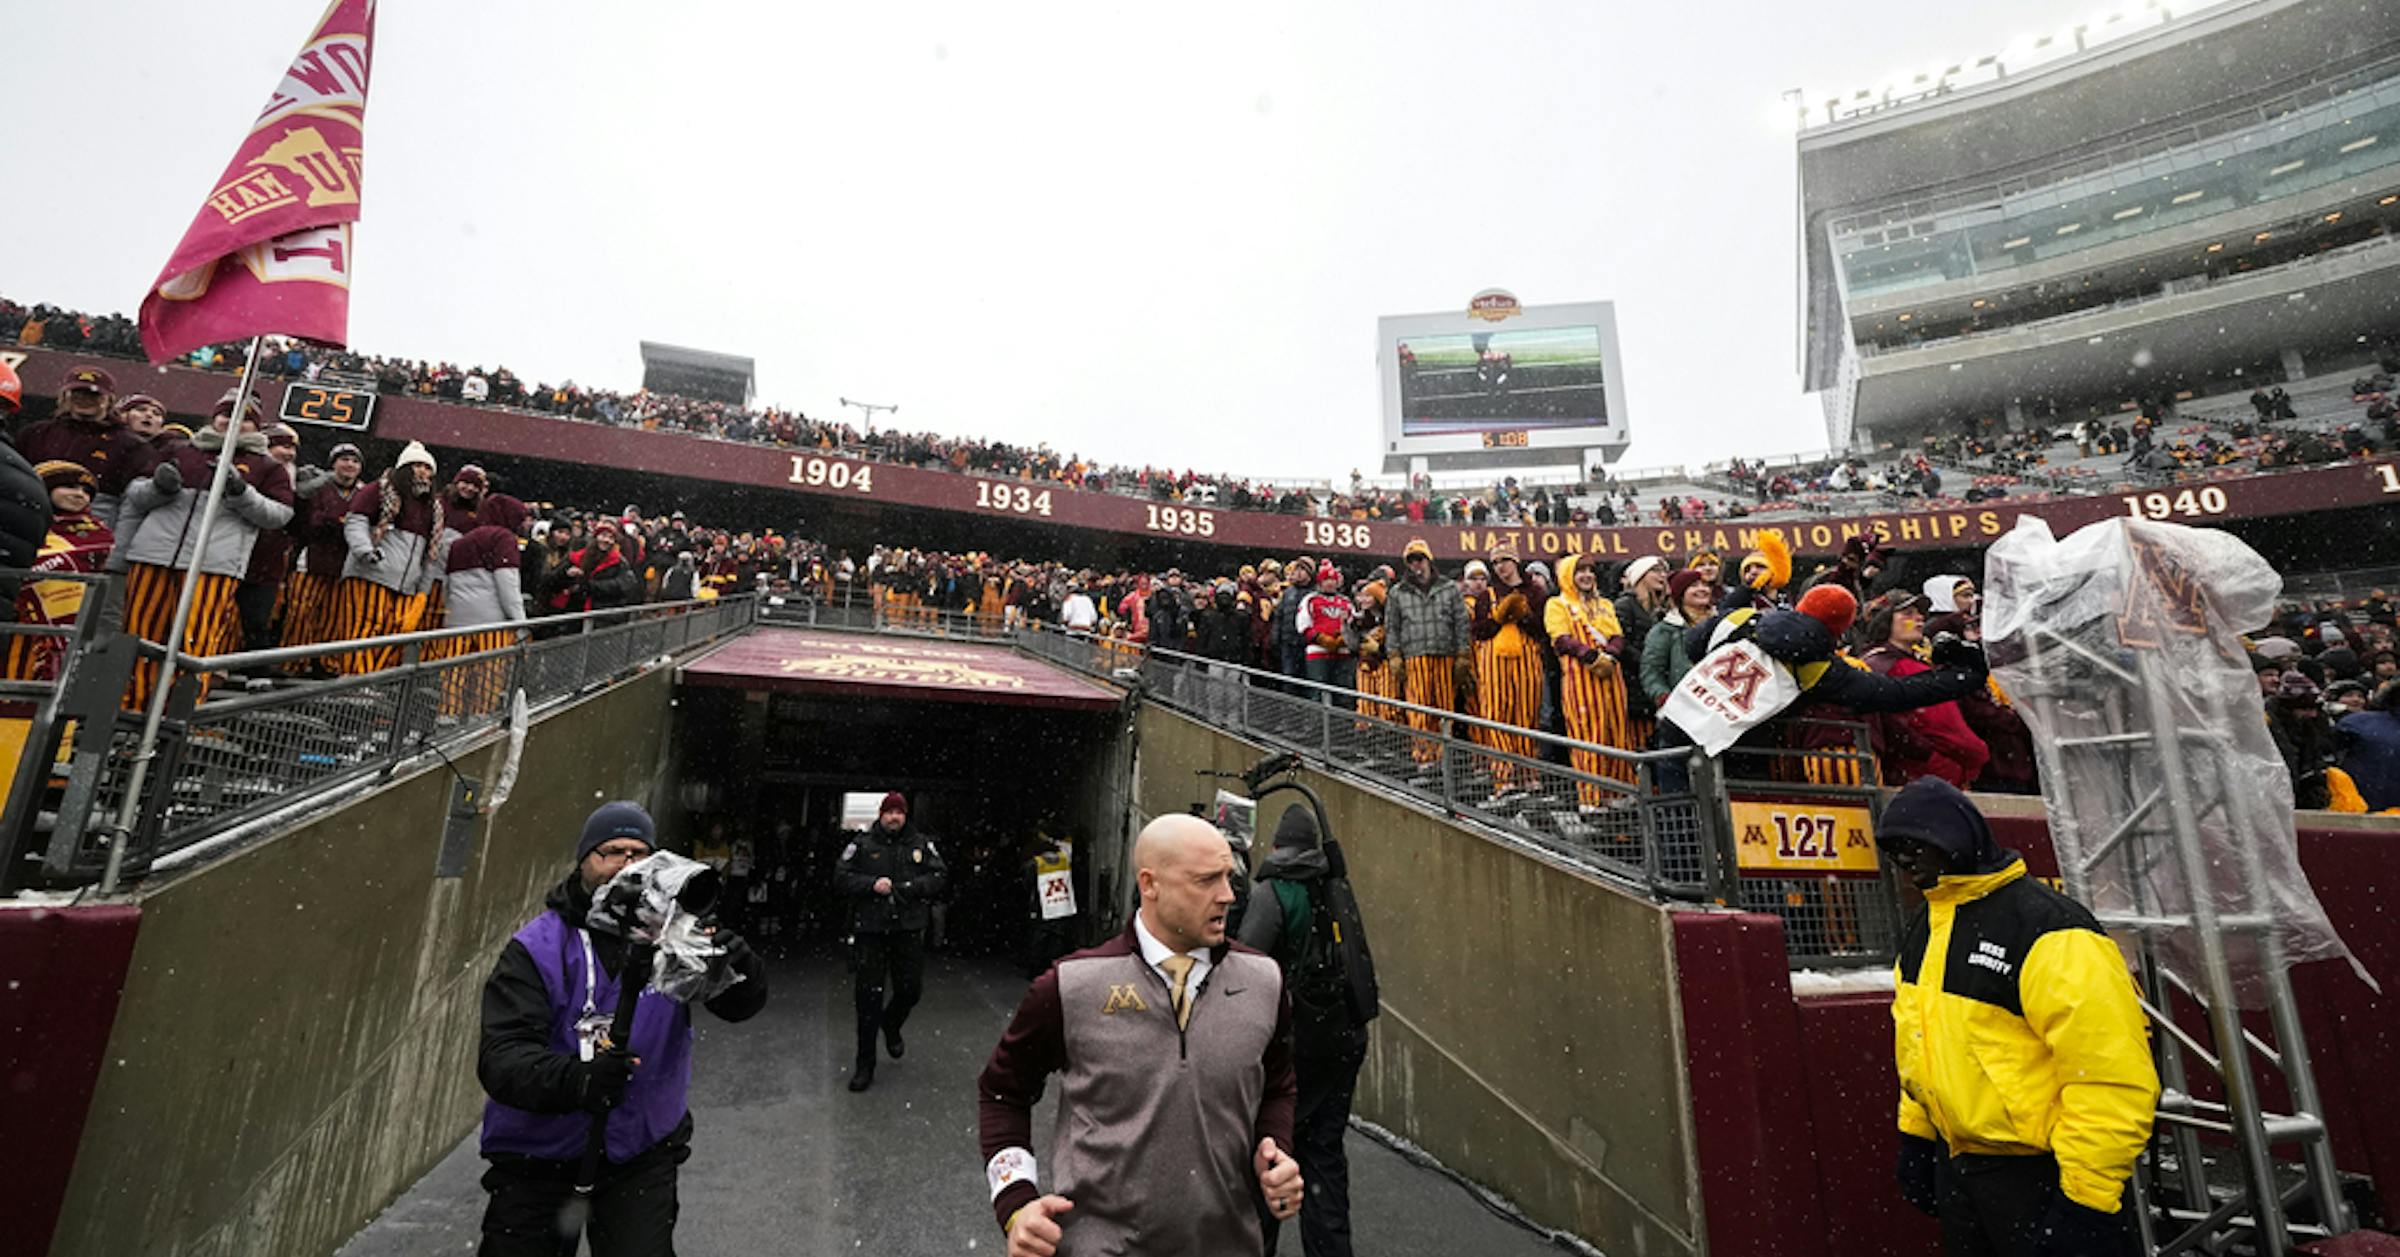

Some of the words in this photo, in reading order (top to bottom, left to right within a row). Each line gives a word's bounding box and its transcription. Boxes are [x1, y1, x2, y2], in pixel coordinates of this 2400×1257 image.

[301, 389, 353, 422] 25
[788, 456, 872, 492] 1904
[975, 481, 1052, 516] 1934
[2122, 487, 2228, 521] 1940
[1146, 504, 1215, 536] 1935
[1302, 520, 1371, 549] 1936
[1460, 530, 1629, 554] NATIONAL
[1773, 813, 1838, 860] 127
